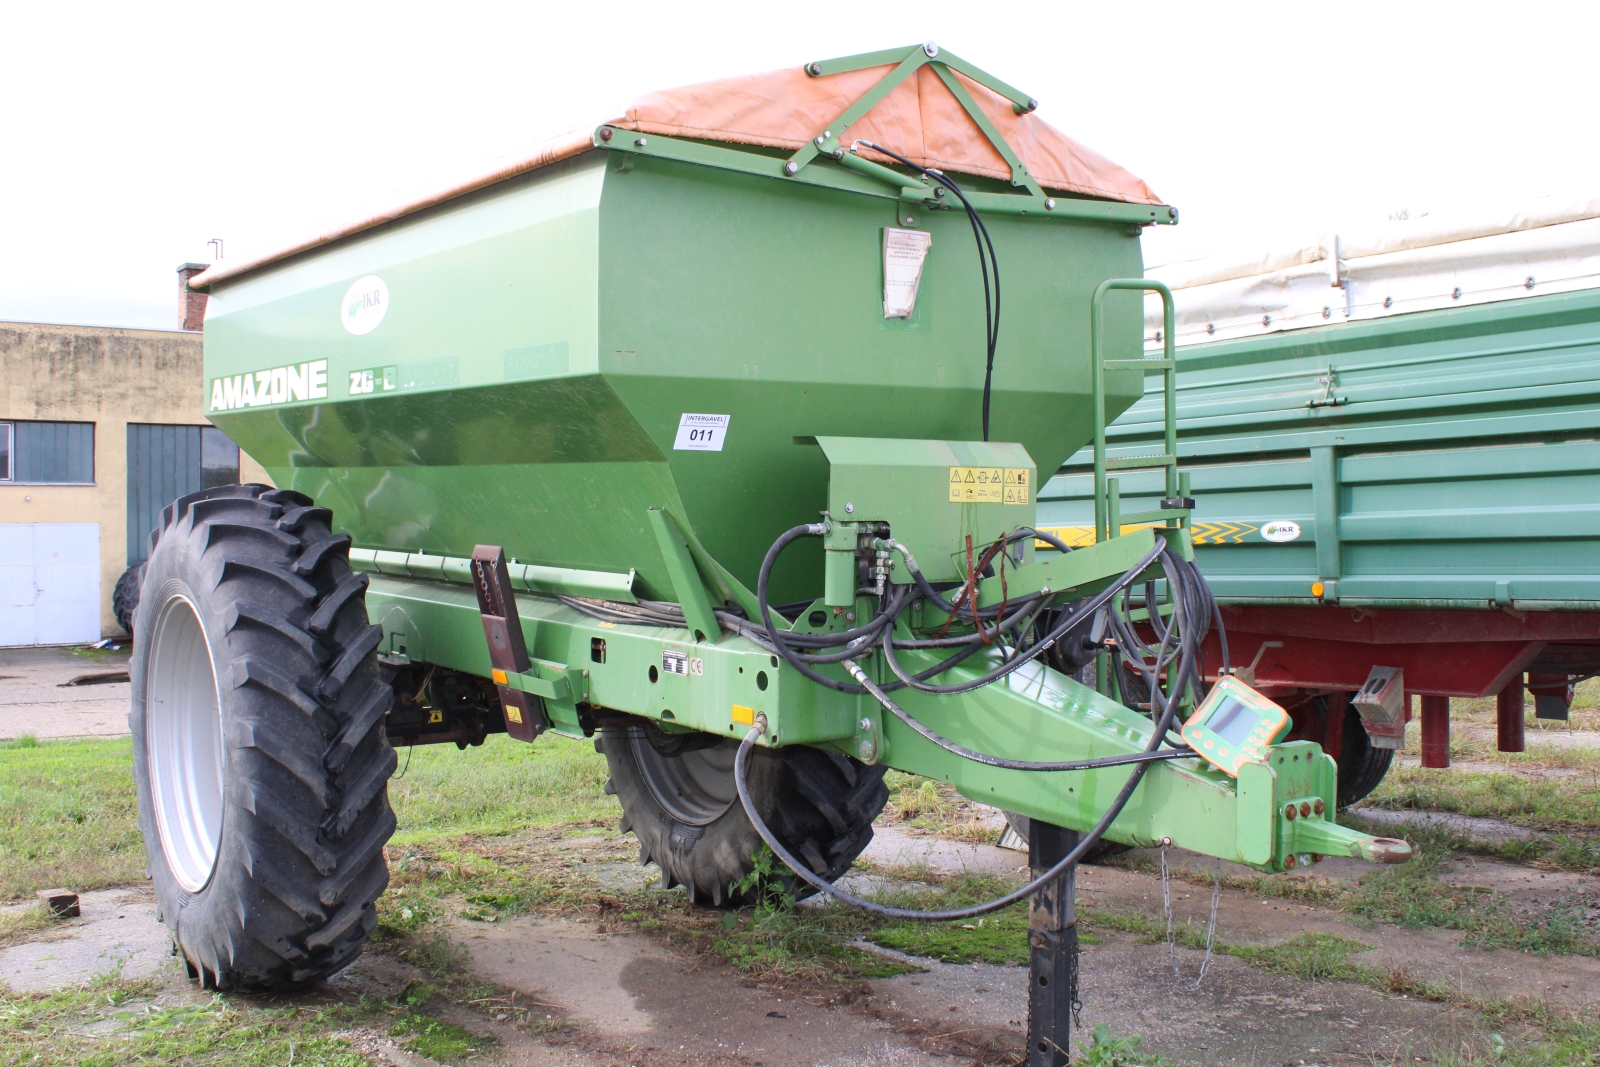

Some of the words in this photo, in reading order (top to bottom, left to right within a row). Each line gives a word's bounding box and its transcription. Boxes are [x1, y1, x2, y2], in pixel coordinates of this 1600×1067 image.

[362, 289, 381, 310] IKR
[210, 360, 327, 411] AMAZONE
[690, 428, 713, 442] 011
